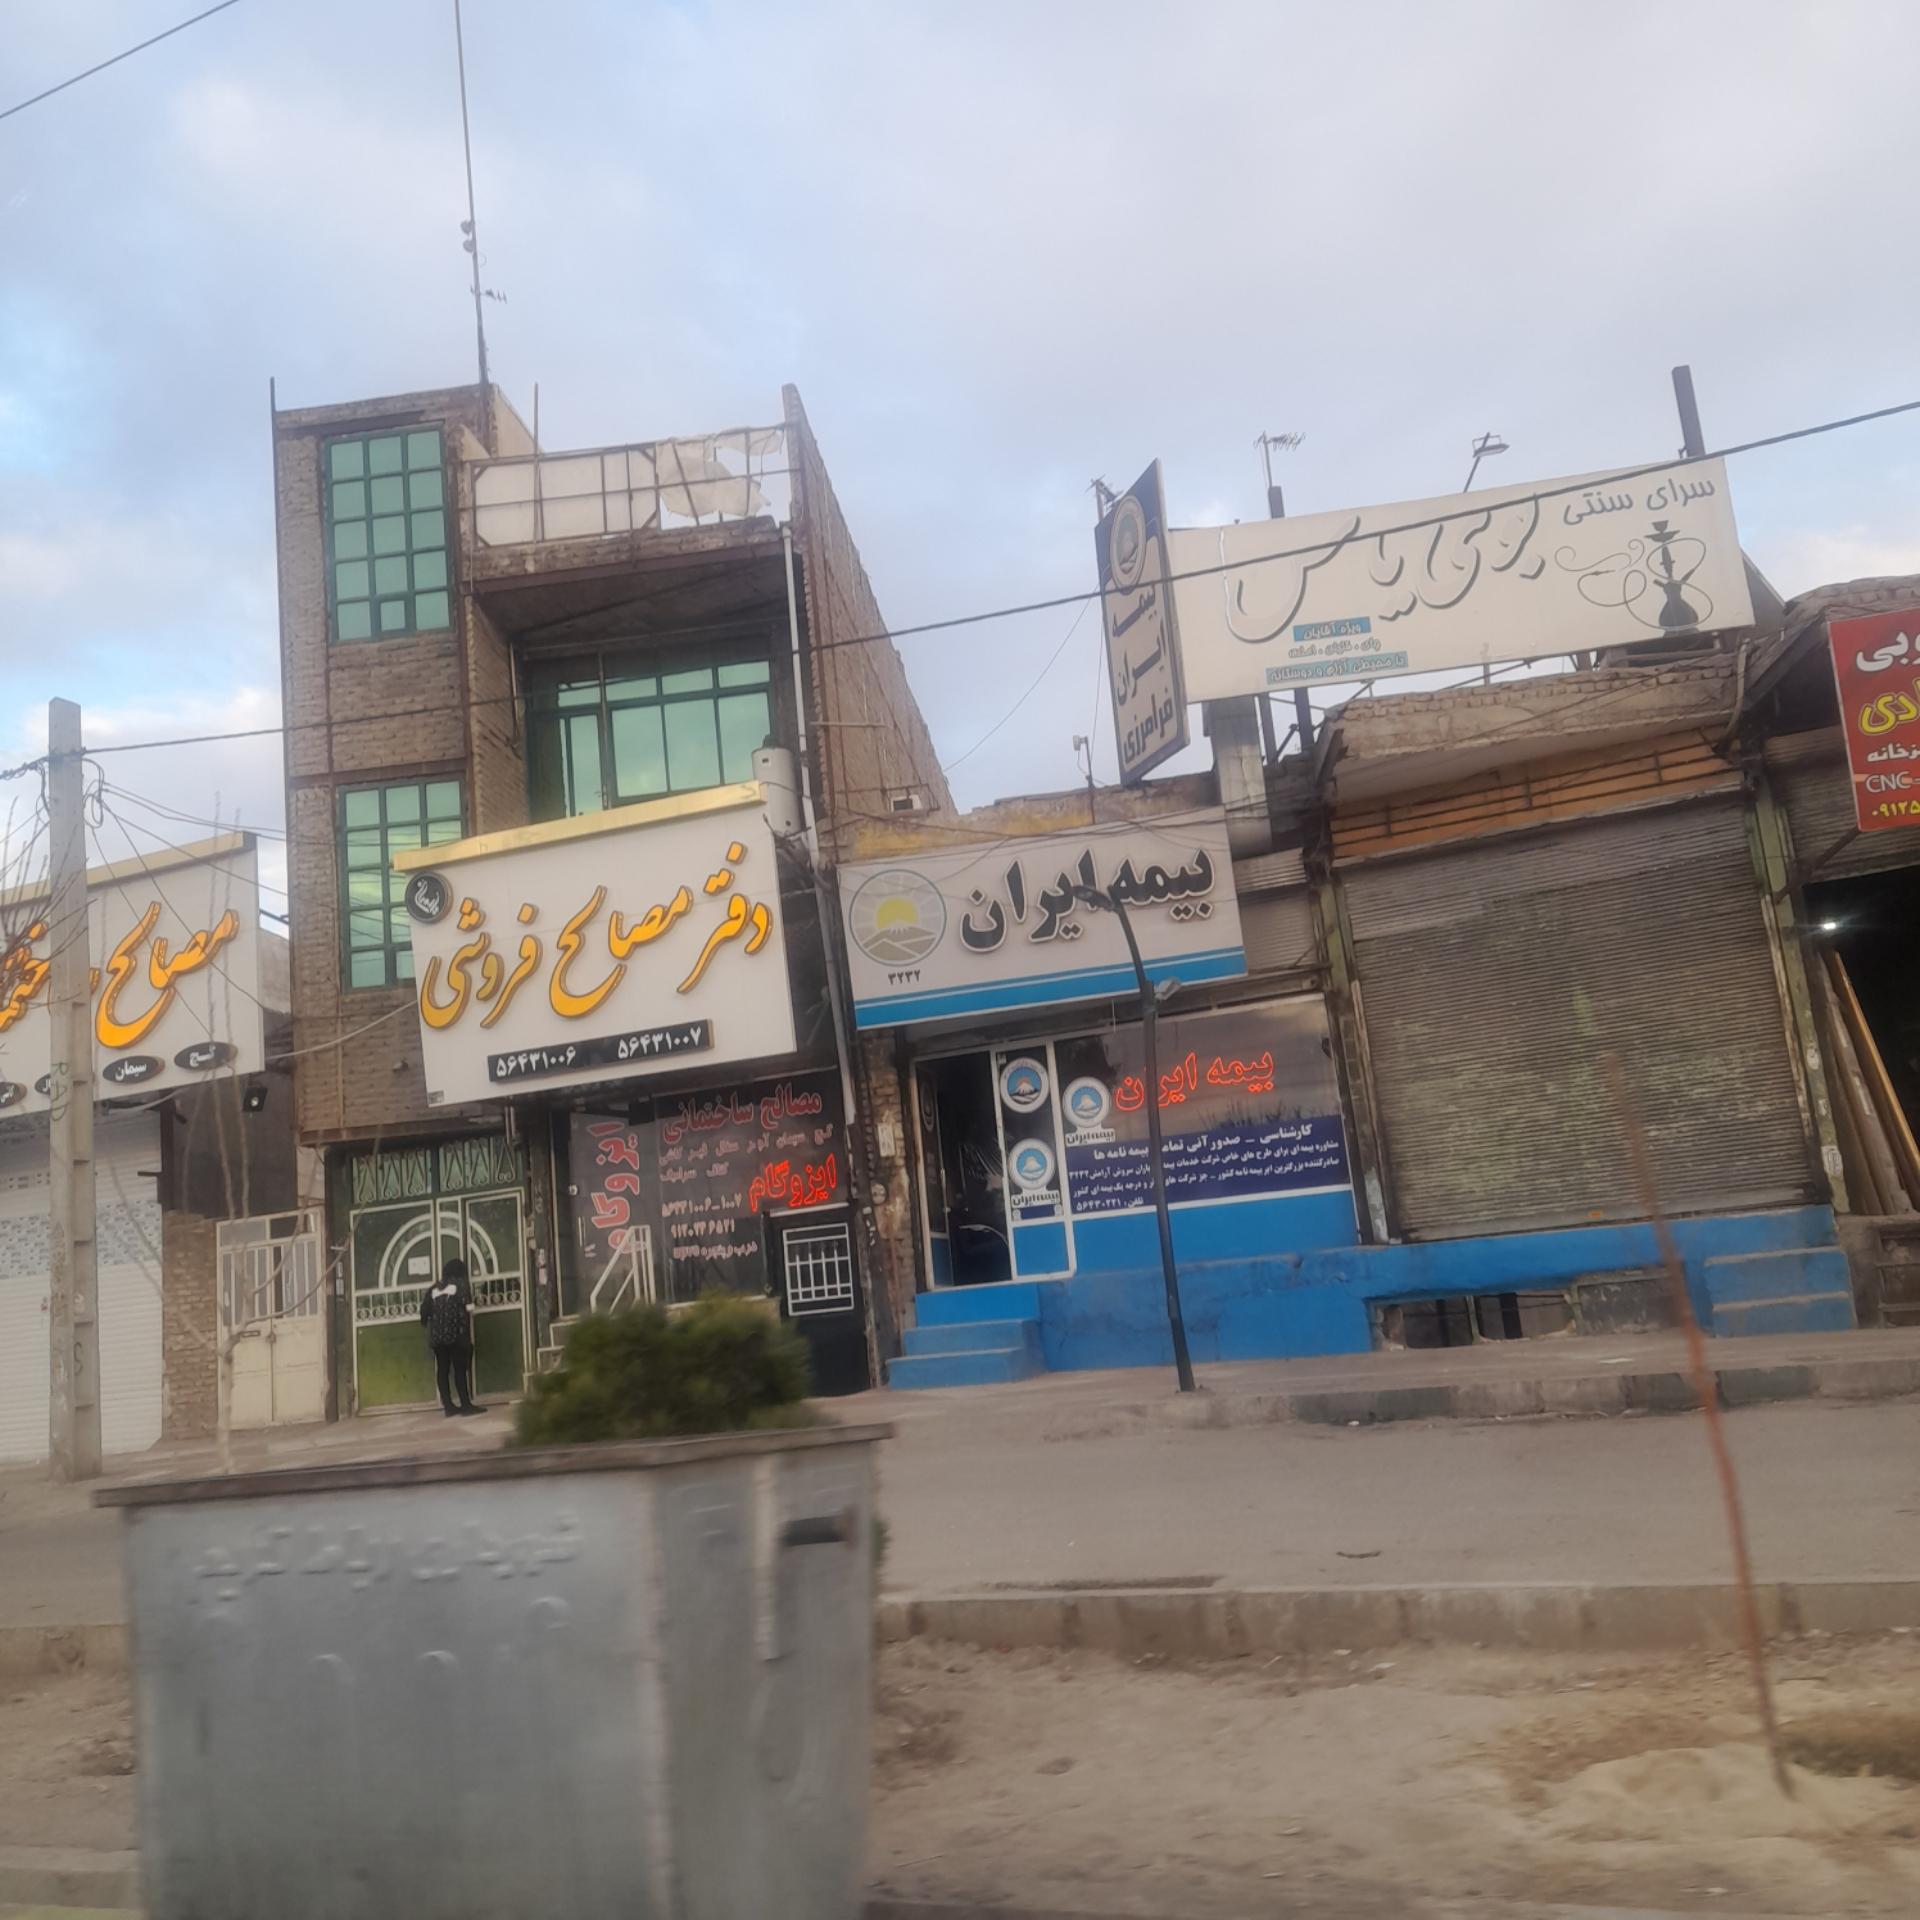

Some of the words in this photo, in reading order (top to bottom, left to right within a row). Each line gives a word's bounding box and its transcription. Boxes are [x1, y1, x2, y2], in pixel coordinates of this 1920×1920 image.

[1563, 490, 1633, 525] سنتی
[1646, 478, 1715, 511] سرای
[1111, 580, 1157, 638] بیمه
[1117, 618, 1168, 706] ایران
[1123, 687, 1174, 764] فرامرزی
[960, 847, 1099, 953] ایران
[1107, 848, 1215, 919] بیمه
[676, 841, 773, 993] دفتر
[420, 897, 543, 1030] فروشی
[549, 884, 694, 1019] مصالح
[95, 901, 240, 1050] مصالح
[617, 1026, 701, 1060] ۵۶۴۳۱۰۰۷
[115, 1060, 148, 1081] سیمان
[495, 1046, 576, 1077] ۵۶۴۳۱۰۰۶
[1206, 1051, 1274, 1092] بیمه
[1115, 1051, 1197, 1112] ایرن
[662, 1092, 754, 1144] ساختمانی
[760, 1081, 823, 1130] مصالح
[1161, 1139, 1184, 1153] تمام
[1187, 1134, 1209, 1153] آنی
[1210, 1136, 1241, 1151] صدور
[1259, 1123, 1312, 1145] کارشناسی
[1093, 1149, 1105, 1160] ها
[1106, 1146, 1127, 1158] نامه
[1128, 1146, 1149, 1158] بیمه
[1163, 1161, 1175, 1170] بیم
[1176, 1157, 1199, 1168] خدمات
[1201, 1154, 1220, 1167] شرکت
[749, 1152, 836, 1213] ایزوگام
[1178, 1172, 1197, 1184] شرکت
[1217, 1169, 1235, 1181] کشور
